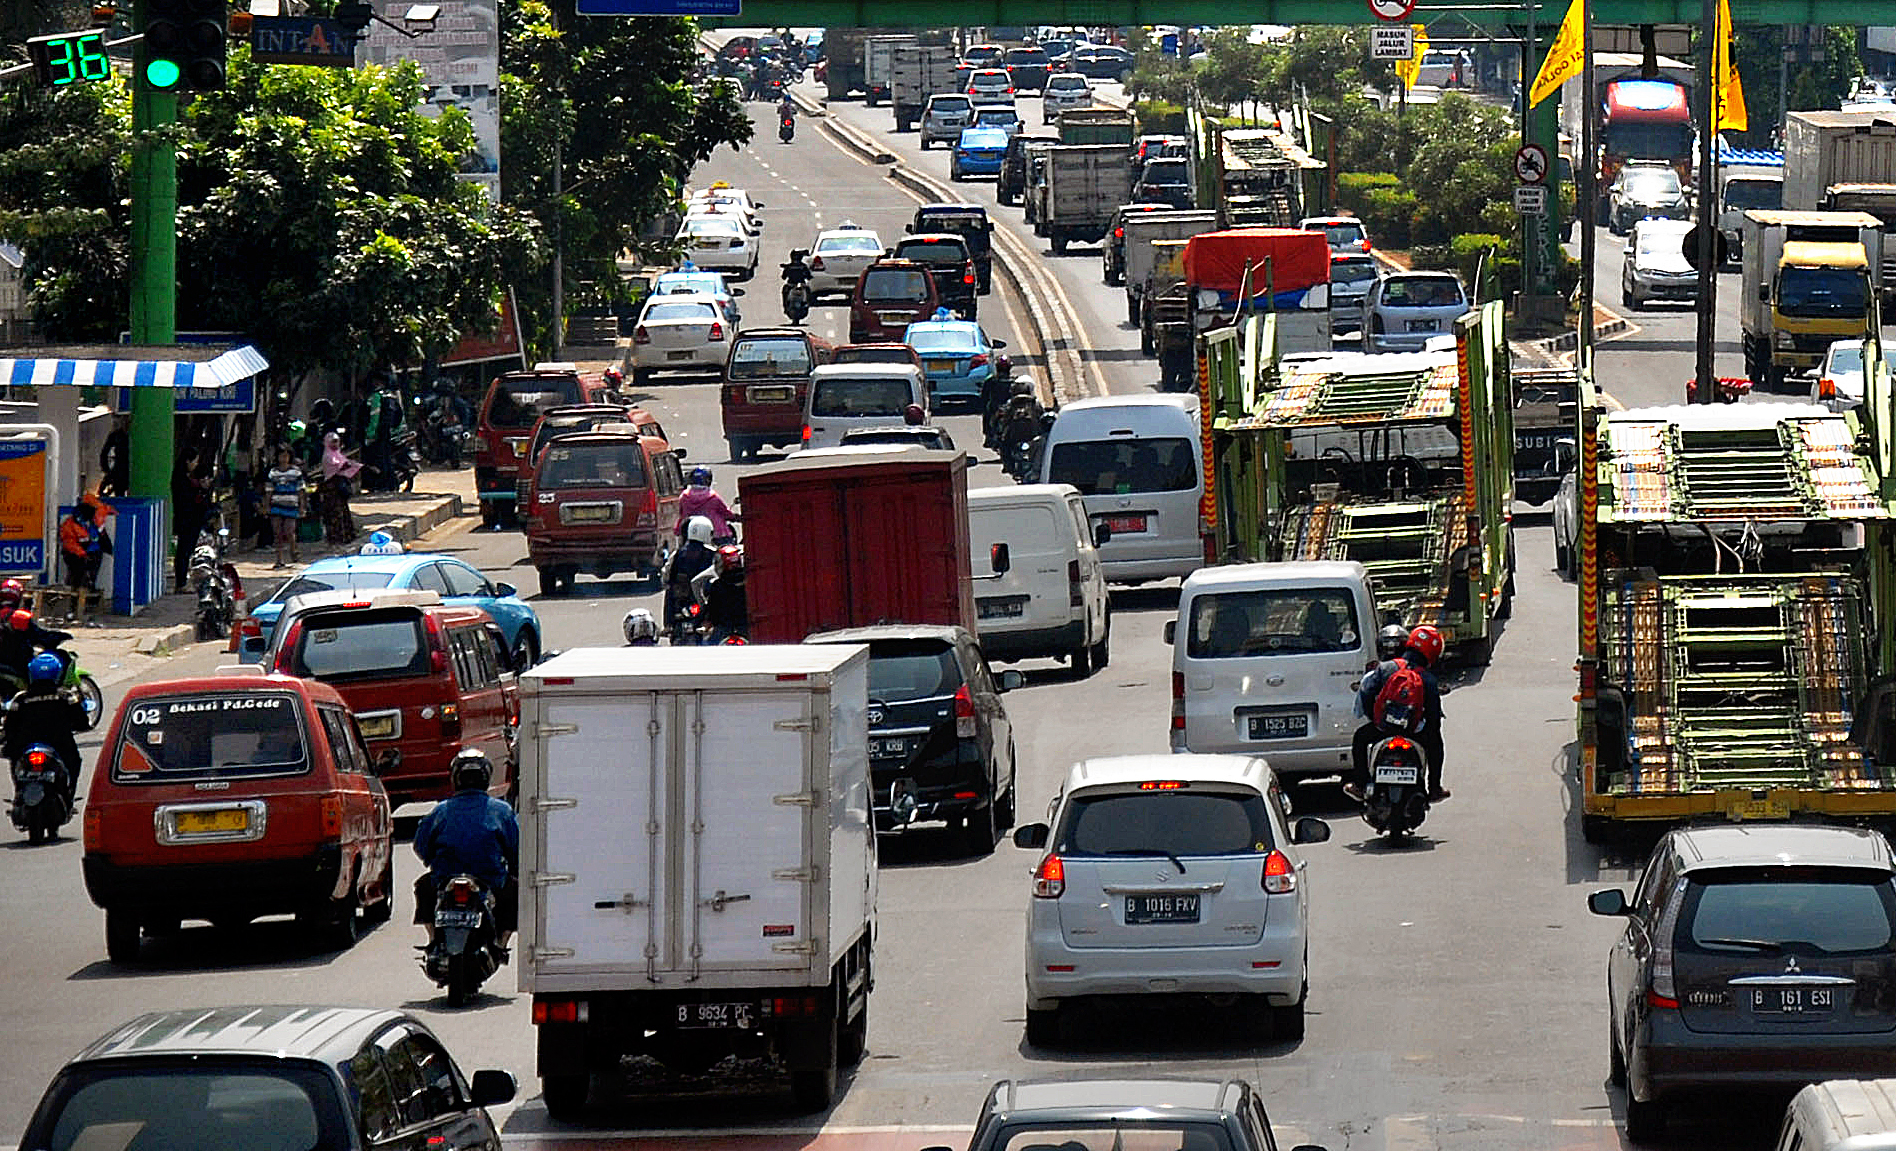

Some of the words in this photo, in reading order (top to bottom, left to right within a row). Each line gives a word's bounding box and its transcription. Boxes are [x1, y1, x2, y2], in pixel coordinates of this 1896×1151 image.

[47, 35, 109, 85] 36
[132, 708, 160, 726] 02
[1126, 896, 1137, 913] B
[1145, 896, 1172, 913] 1016
[1175, 896, 1198, 913] FXV
[1754, 990, 1763, 1006] B
[1780, 990, 1802, 1006] 161
[677, 1005, 688, 1023] B
[698, 1005, 729, 1021] 9634
